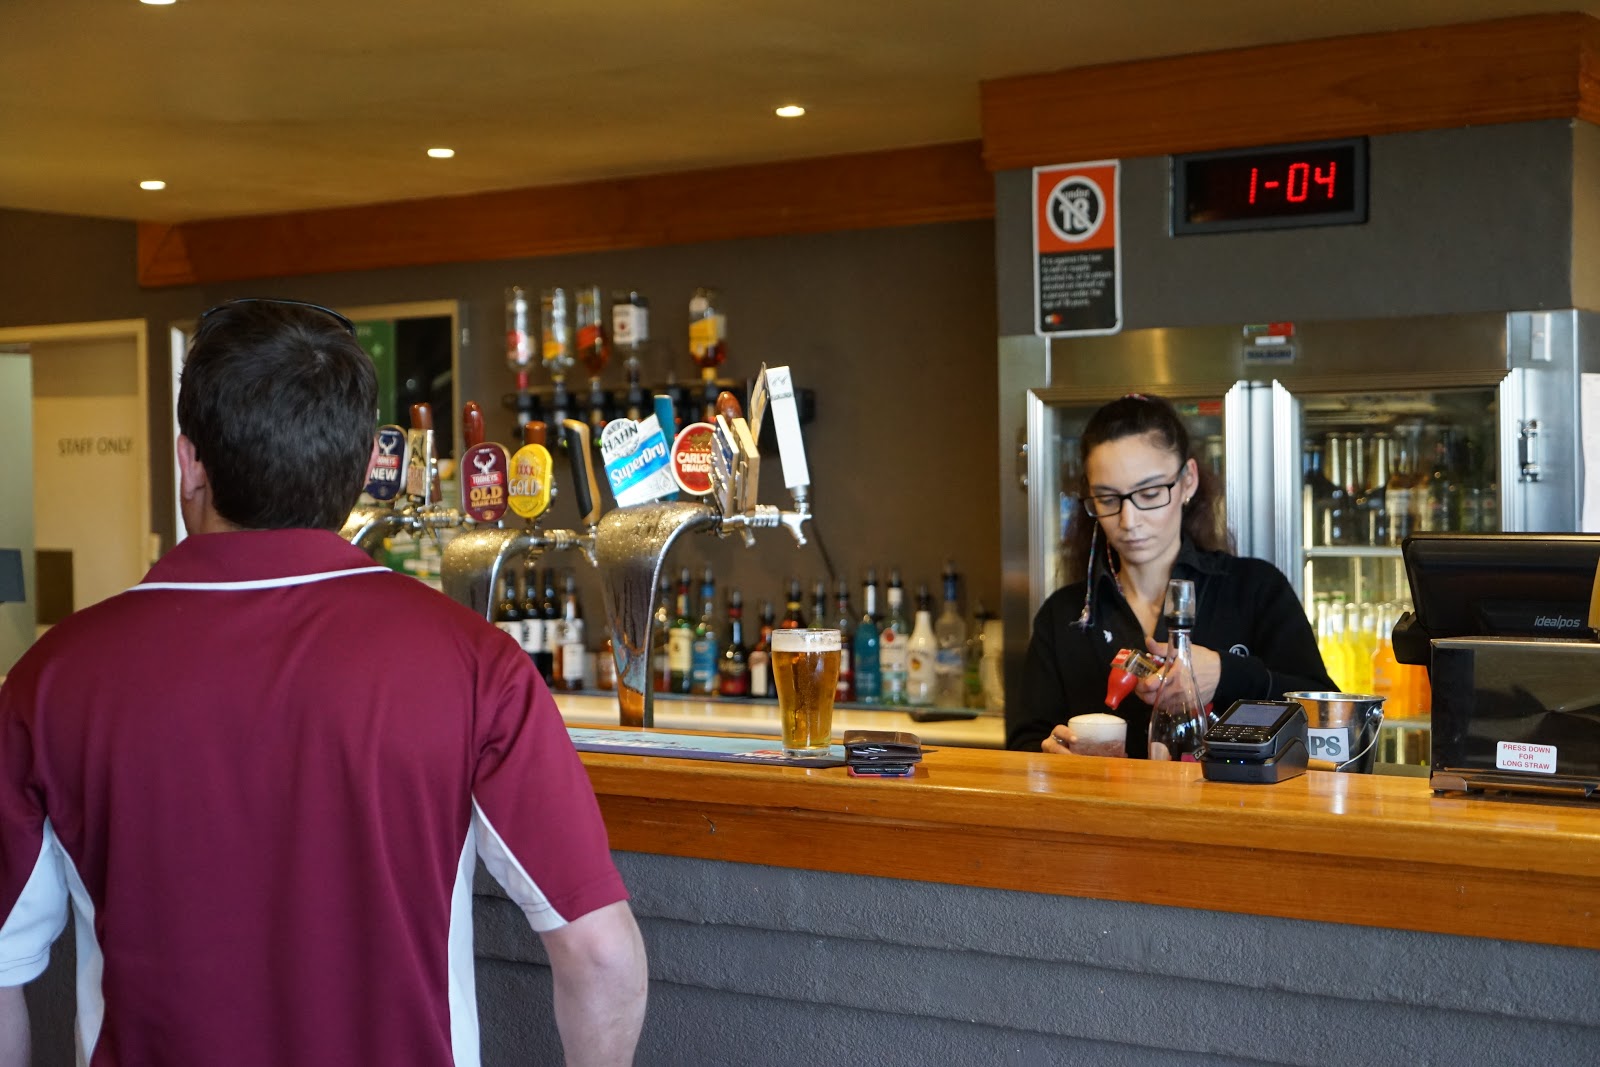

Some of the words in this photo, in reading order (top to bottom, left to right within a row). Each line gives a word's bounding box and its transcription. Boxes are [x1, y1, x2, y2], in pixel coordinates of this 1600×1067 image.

[1249, 161, 1337, 205] 1-04
[603, 423, 639, 454] HAHN
[58, 437, 94, 457] STAFF
[96, 436, 134, 456] ONLY
[677, 452, 712, 464] CARLTO
[370, 467, 397, 481] NEW
[681, 464, 712, 473] DRAUGH
[470, 486, 503, 501] OLD
[508, 479, 539, 497] GOLD
[1534, 615, 1581, 629] idealpos
[1503, 744, 1527, 752] PRESS
[1524, 762, 1550, 770] STRAW
